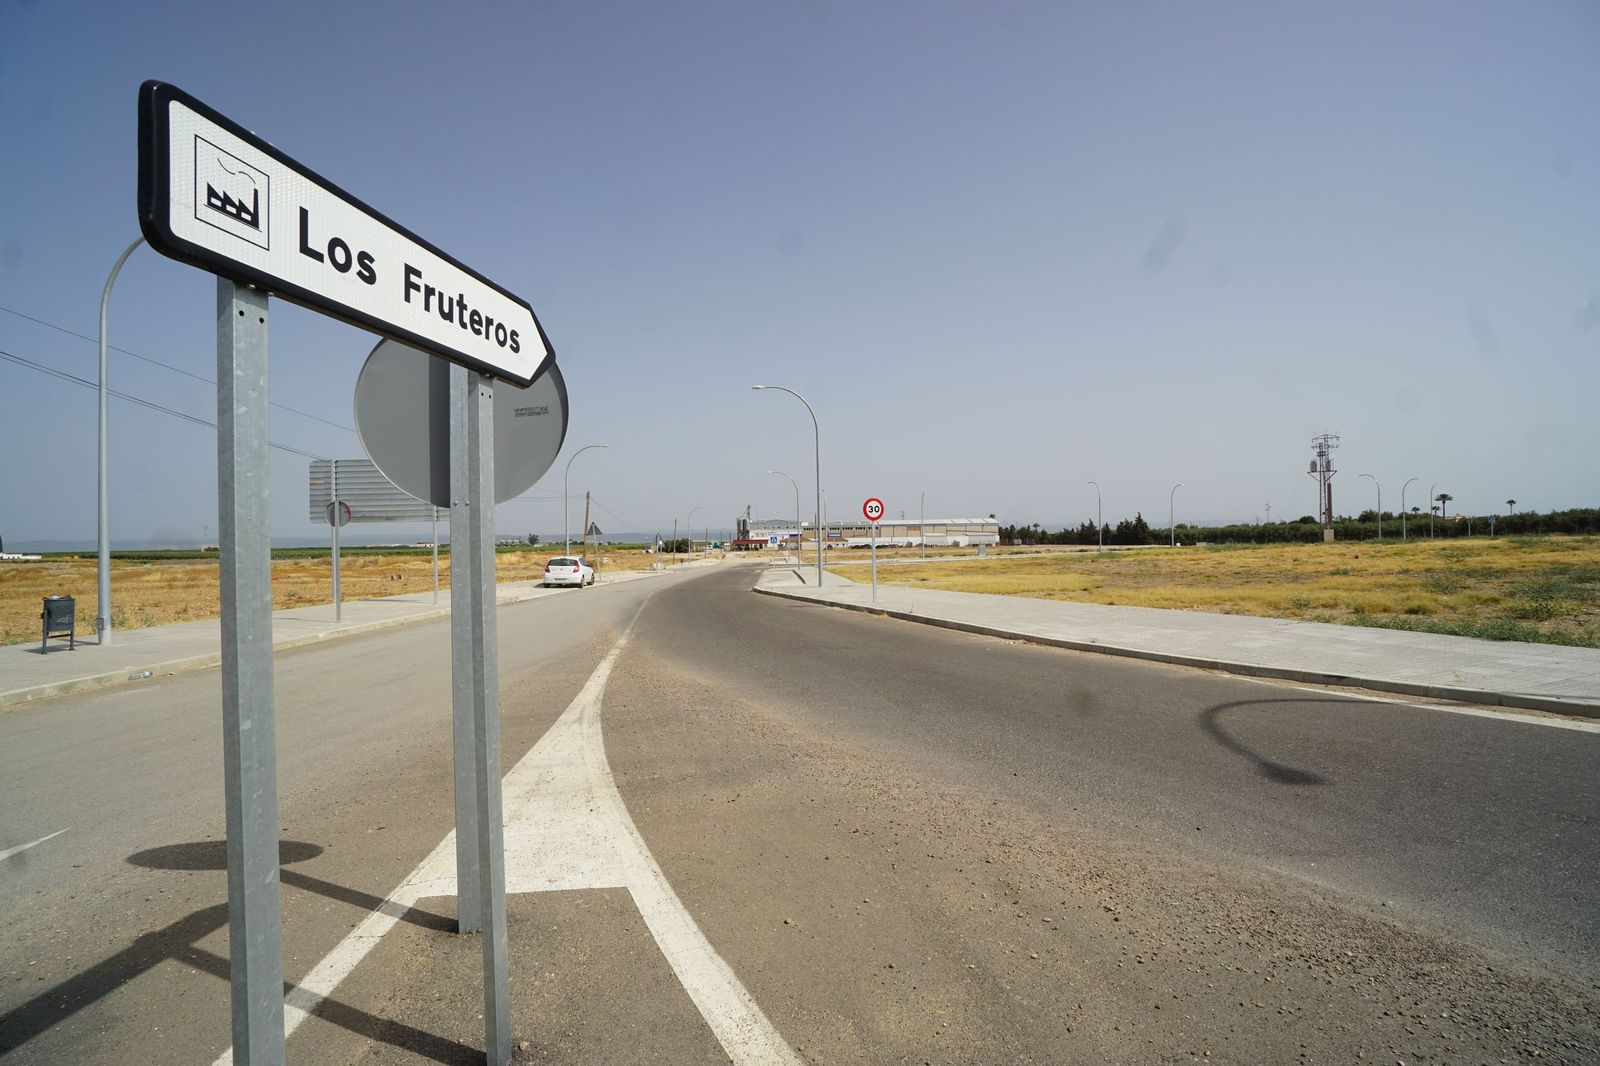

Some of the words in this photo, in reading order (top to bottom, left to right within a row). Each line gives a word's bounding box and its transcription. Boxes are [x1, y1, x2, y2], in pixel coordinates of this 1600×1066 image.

[299, 206, 376, 285] Los
[404, 262, 521, 354] Fruteros
[868, 505, 880, 513] 30
